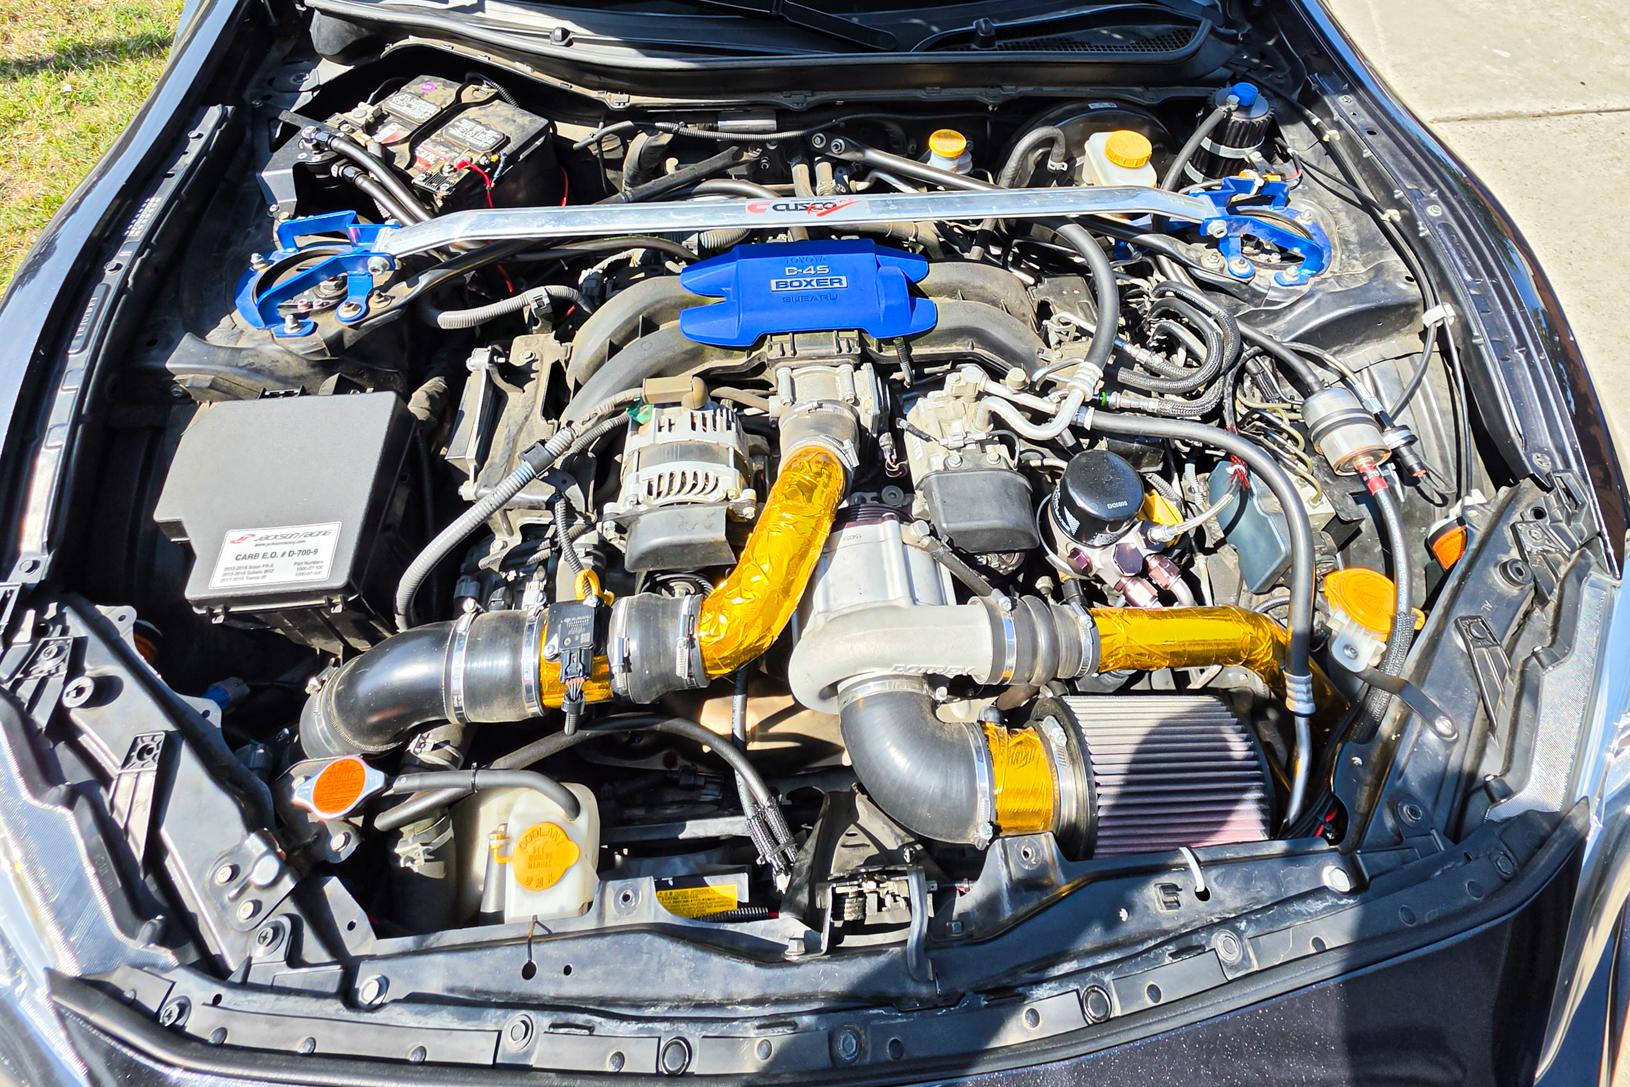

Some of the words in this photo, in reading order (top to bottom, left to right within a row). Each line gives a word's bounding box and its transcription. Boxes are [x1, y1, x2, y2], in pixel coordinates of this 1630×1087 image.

[772, 201, 837, 212] CUSCO
[784, 265, 831, 276] D-4S
[775, 277, 844, 289] BOXER
[235, 552, 260, 561] CARB
